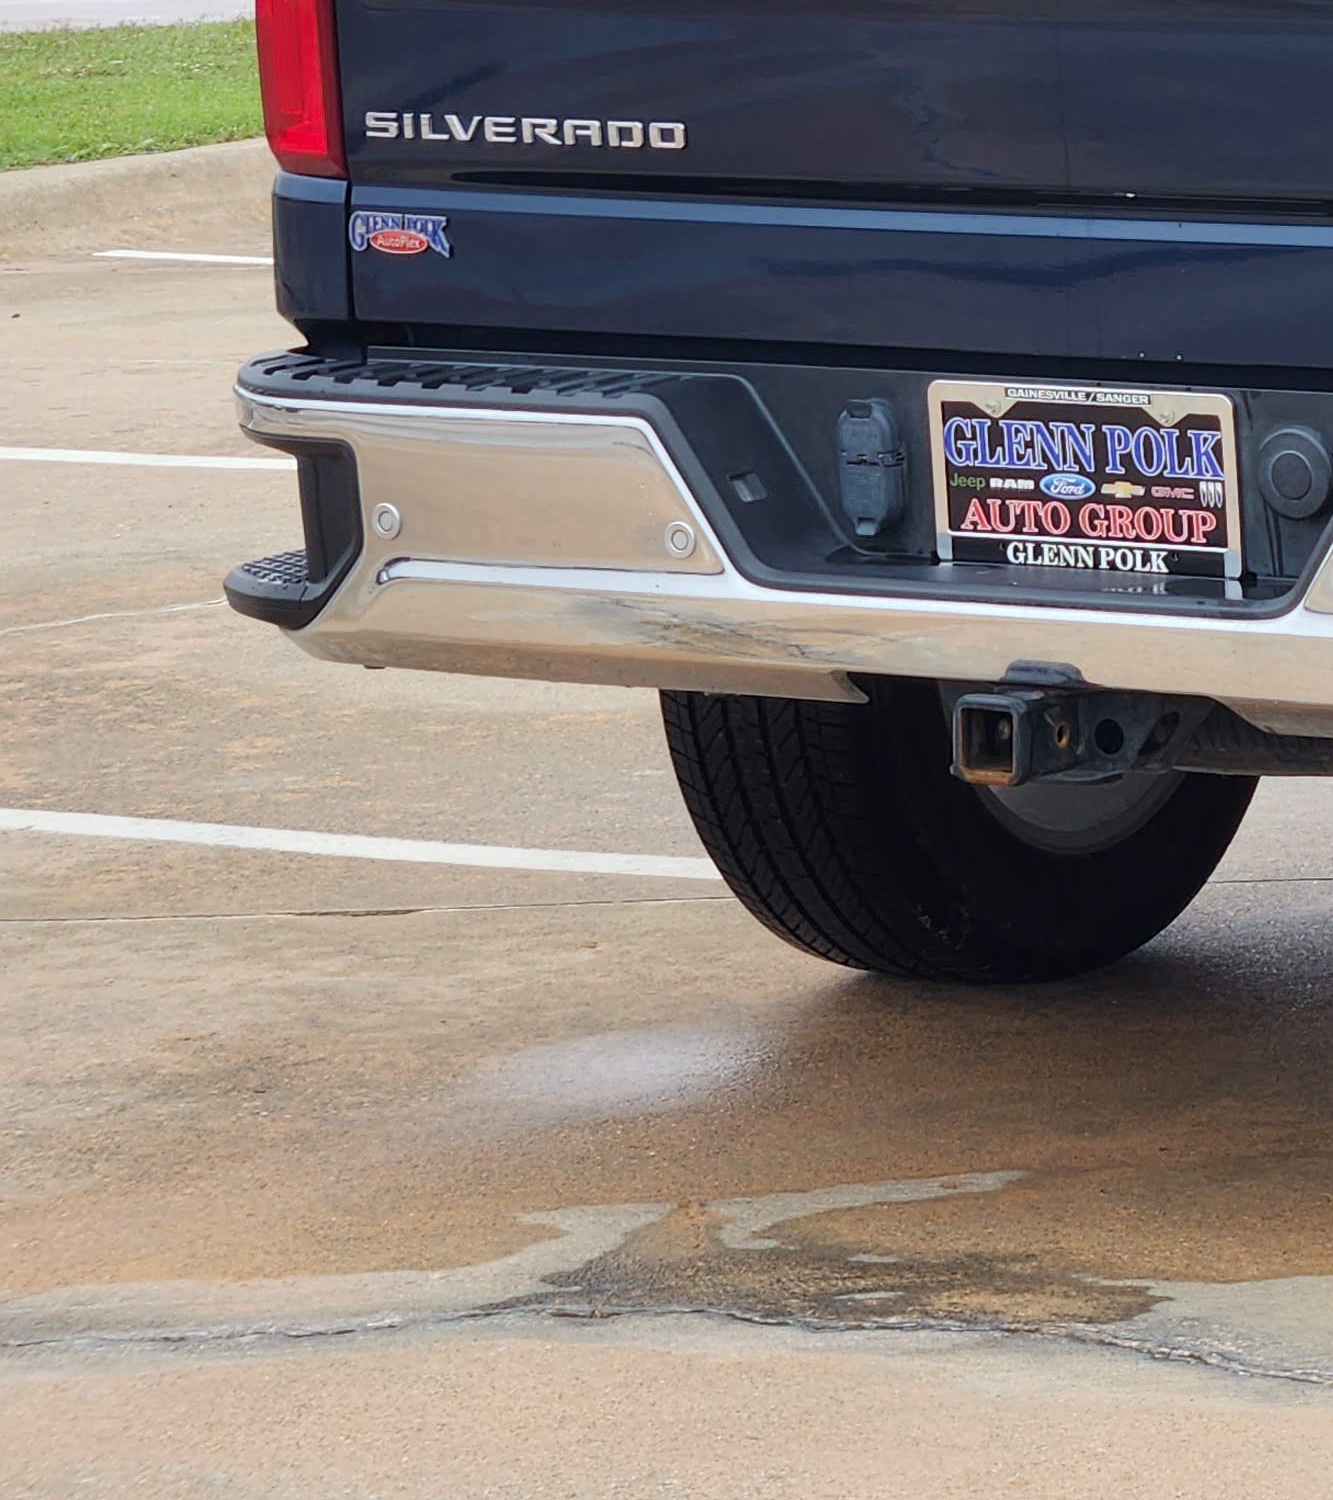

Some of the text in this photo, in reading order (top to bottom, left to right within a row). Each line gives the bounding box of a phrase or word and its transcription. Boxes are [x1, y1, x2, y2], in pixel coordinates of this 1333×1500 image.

[365, 111, 687, 149] SILVERADO
[1007, 388, 1087, 401] GAINESVILLE
[1096, 393, 1149, 405] SANGER
[944, 417, 1225, 480] GLENN POLK
[950, 472, 985, 491] Jeep
[989, 477, 1035, 491] RAM
[1150, 486, 1195, 500] GMC
[960, 497, 1217, 544] AUTO GROUP
[1006, 541, 1169, 574] GLENN POLK
